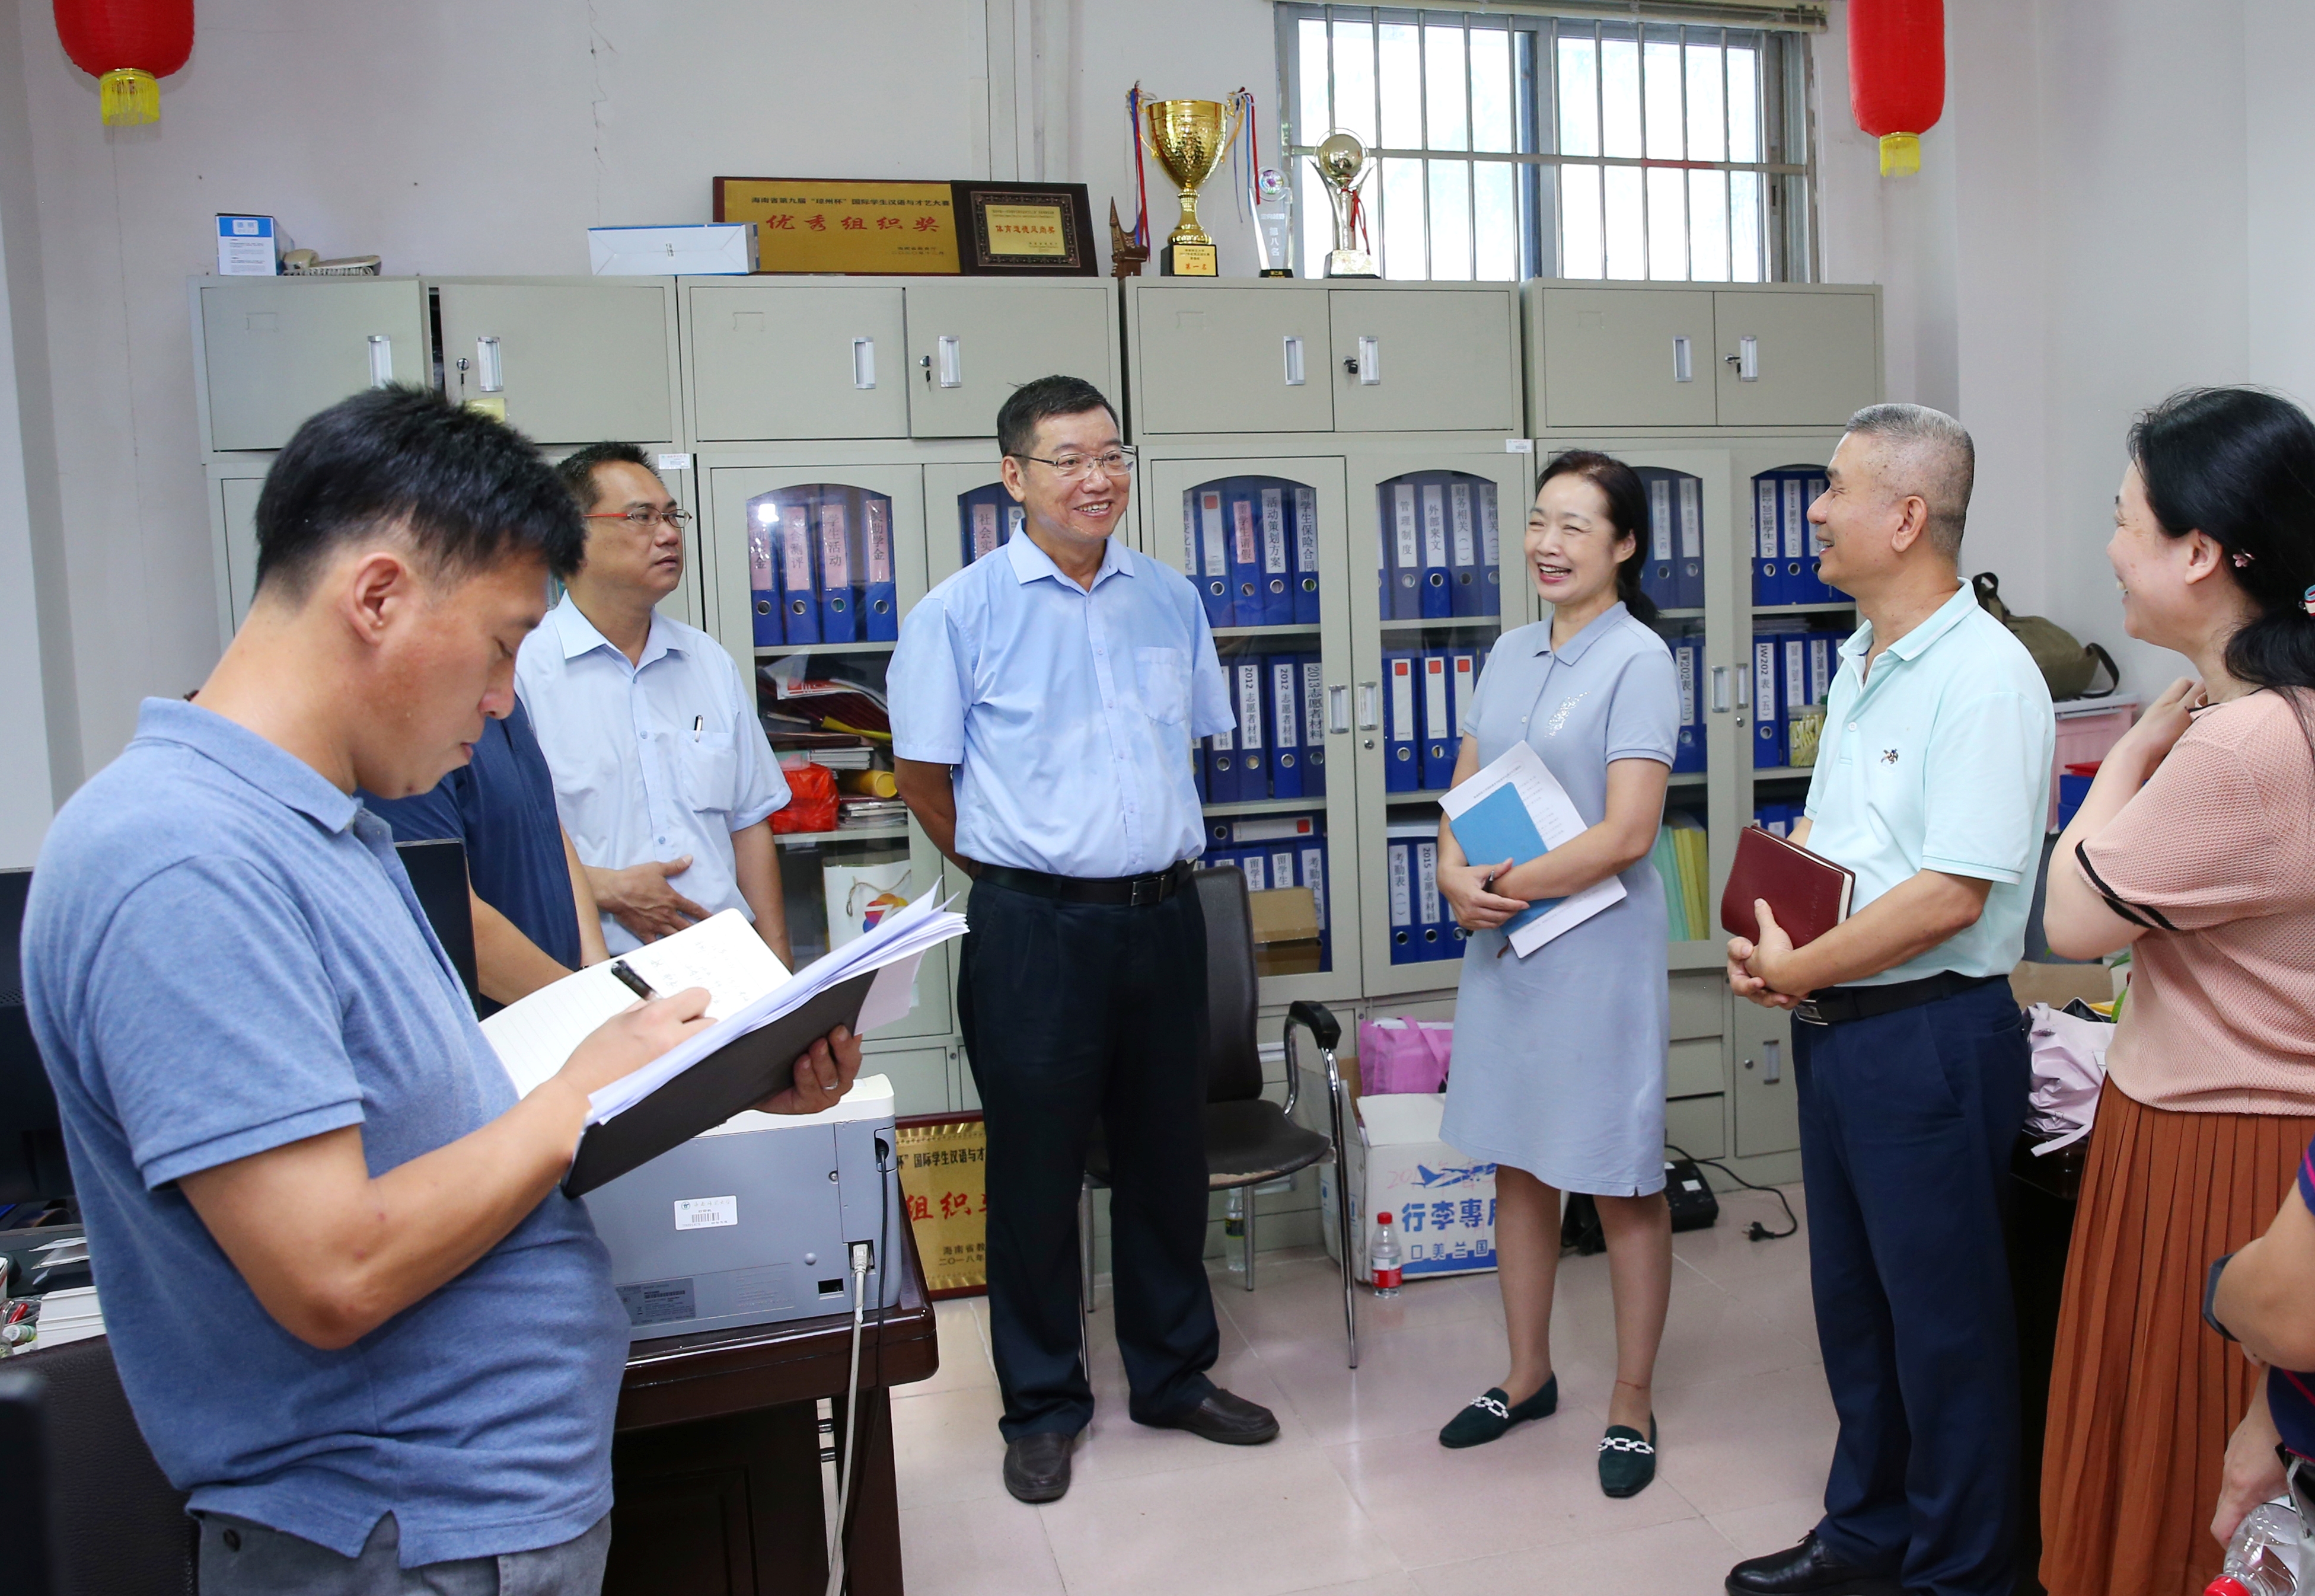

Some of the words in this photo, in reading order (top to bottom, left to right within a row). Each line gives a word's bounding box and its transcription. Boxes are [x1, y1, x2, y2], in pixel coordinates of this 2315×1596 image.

[766, 215, 940, 232] 优秀组织奖
[827, 513, 841, 566] 学生活动
[871, 509, 885, 560] 奖助学金
[1267, 497, 1281, 567] 活动策划方案
[1300, 489, 1315, 572] 留学生保险合同
[1400, 501, 1412, 554] 管理制度
[1428, 505, 1442, 551] 外部来文
[1455, 486, 1469, 561] 财务相关（一）
[1760, 644, 1769, 675] JW202
[1246, 692, 1258, 746] 志愿者材料
[1281, 693, 1293, 746] 志愿者材料
[1250, 858, 1260, 888] 留学生
[1277, 855, 1288, 885] 留学生
[1394, 853, 1407, 915] 考勤表（一）
[1423, 848, 1431, 869] 2015
[1424, 872, 1434, 921] 志愿者材料
[907, 1190, 987, 1222] 组织
